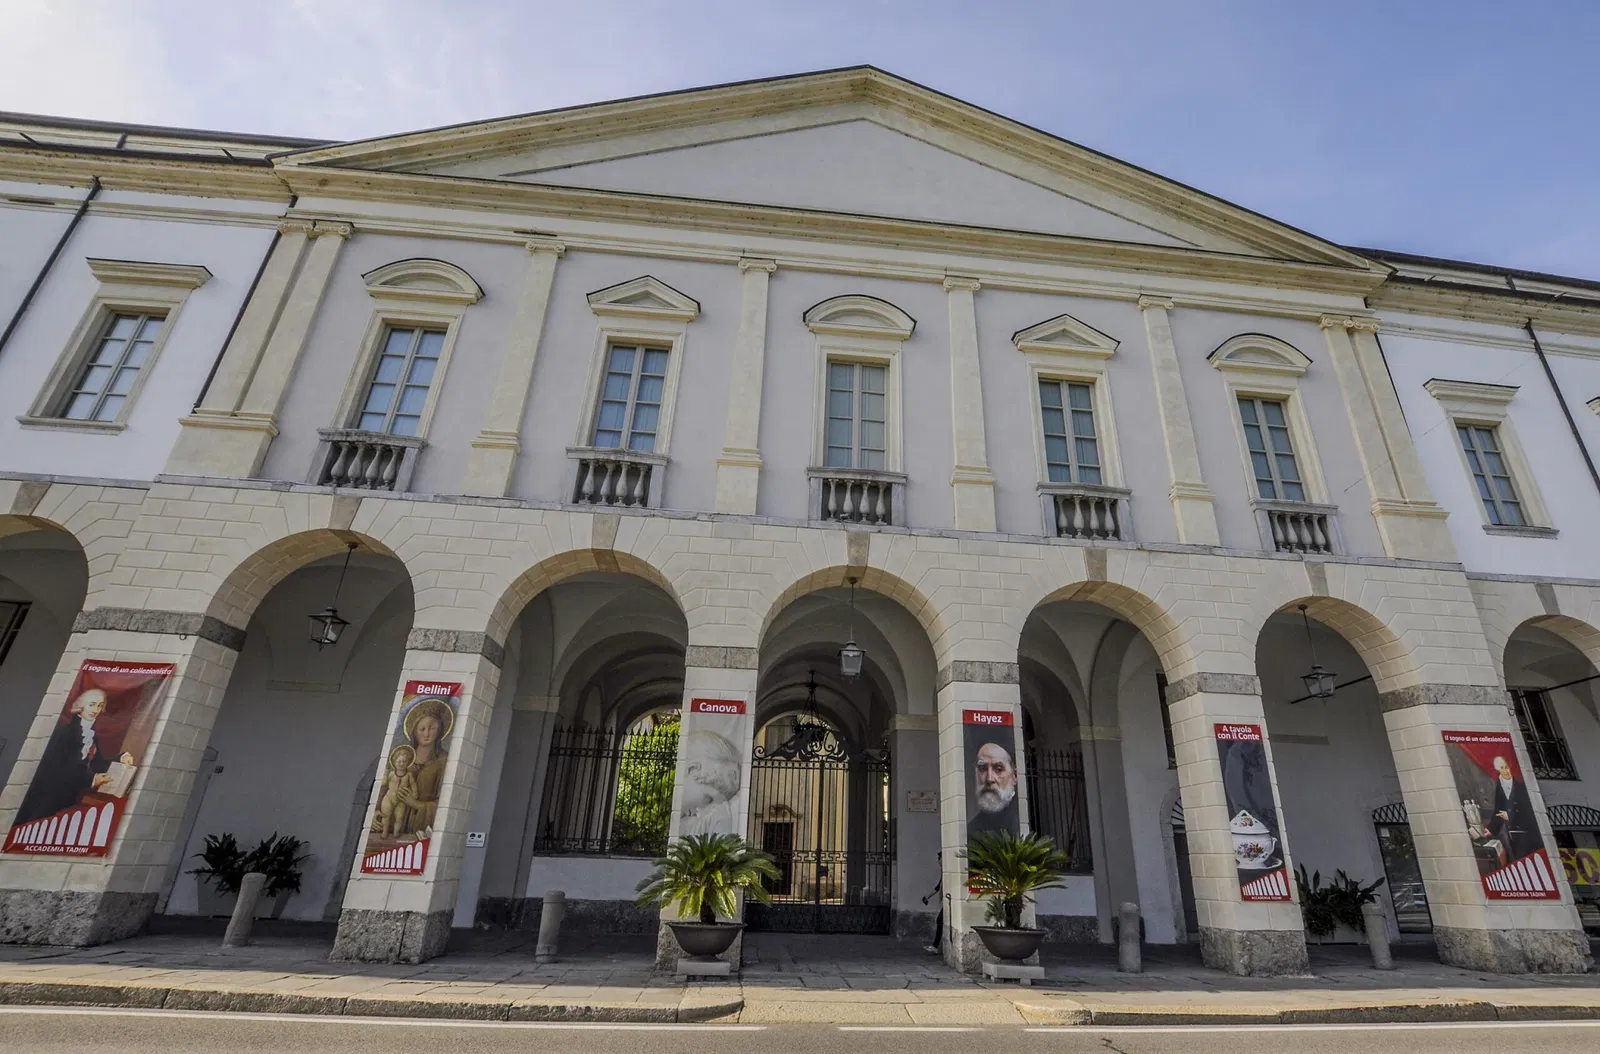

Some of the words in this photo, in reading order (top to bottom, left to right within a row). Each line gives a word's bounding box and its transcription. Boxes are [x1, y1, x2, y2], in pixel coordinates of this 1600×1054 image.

[83, 663, 88, 671] Il
[88, 665, 111, 673] sogno
[130, 667, 172, 675] collezionista
[416, 684, 452, 695] Bellini
[699, 702, 738, 713] Canova
[973, 712, 1003, 725] Hayez
[1229, 725, 1252, 733] tavola
[1231, 732, 1238, 740] il
[1238, 732, 1260, 740] Conte
[24, 845, 64, 853] ACCADEMIA
[65, 846, 89, 854] TADINI
